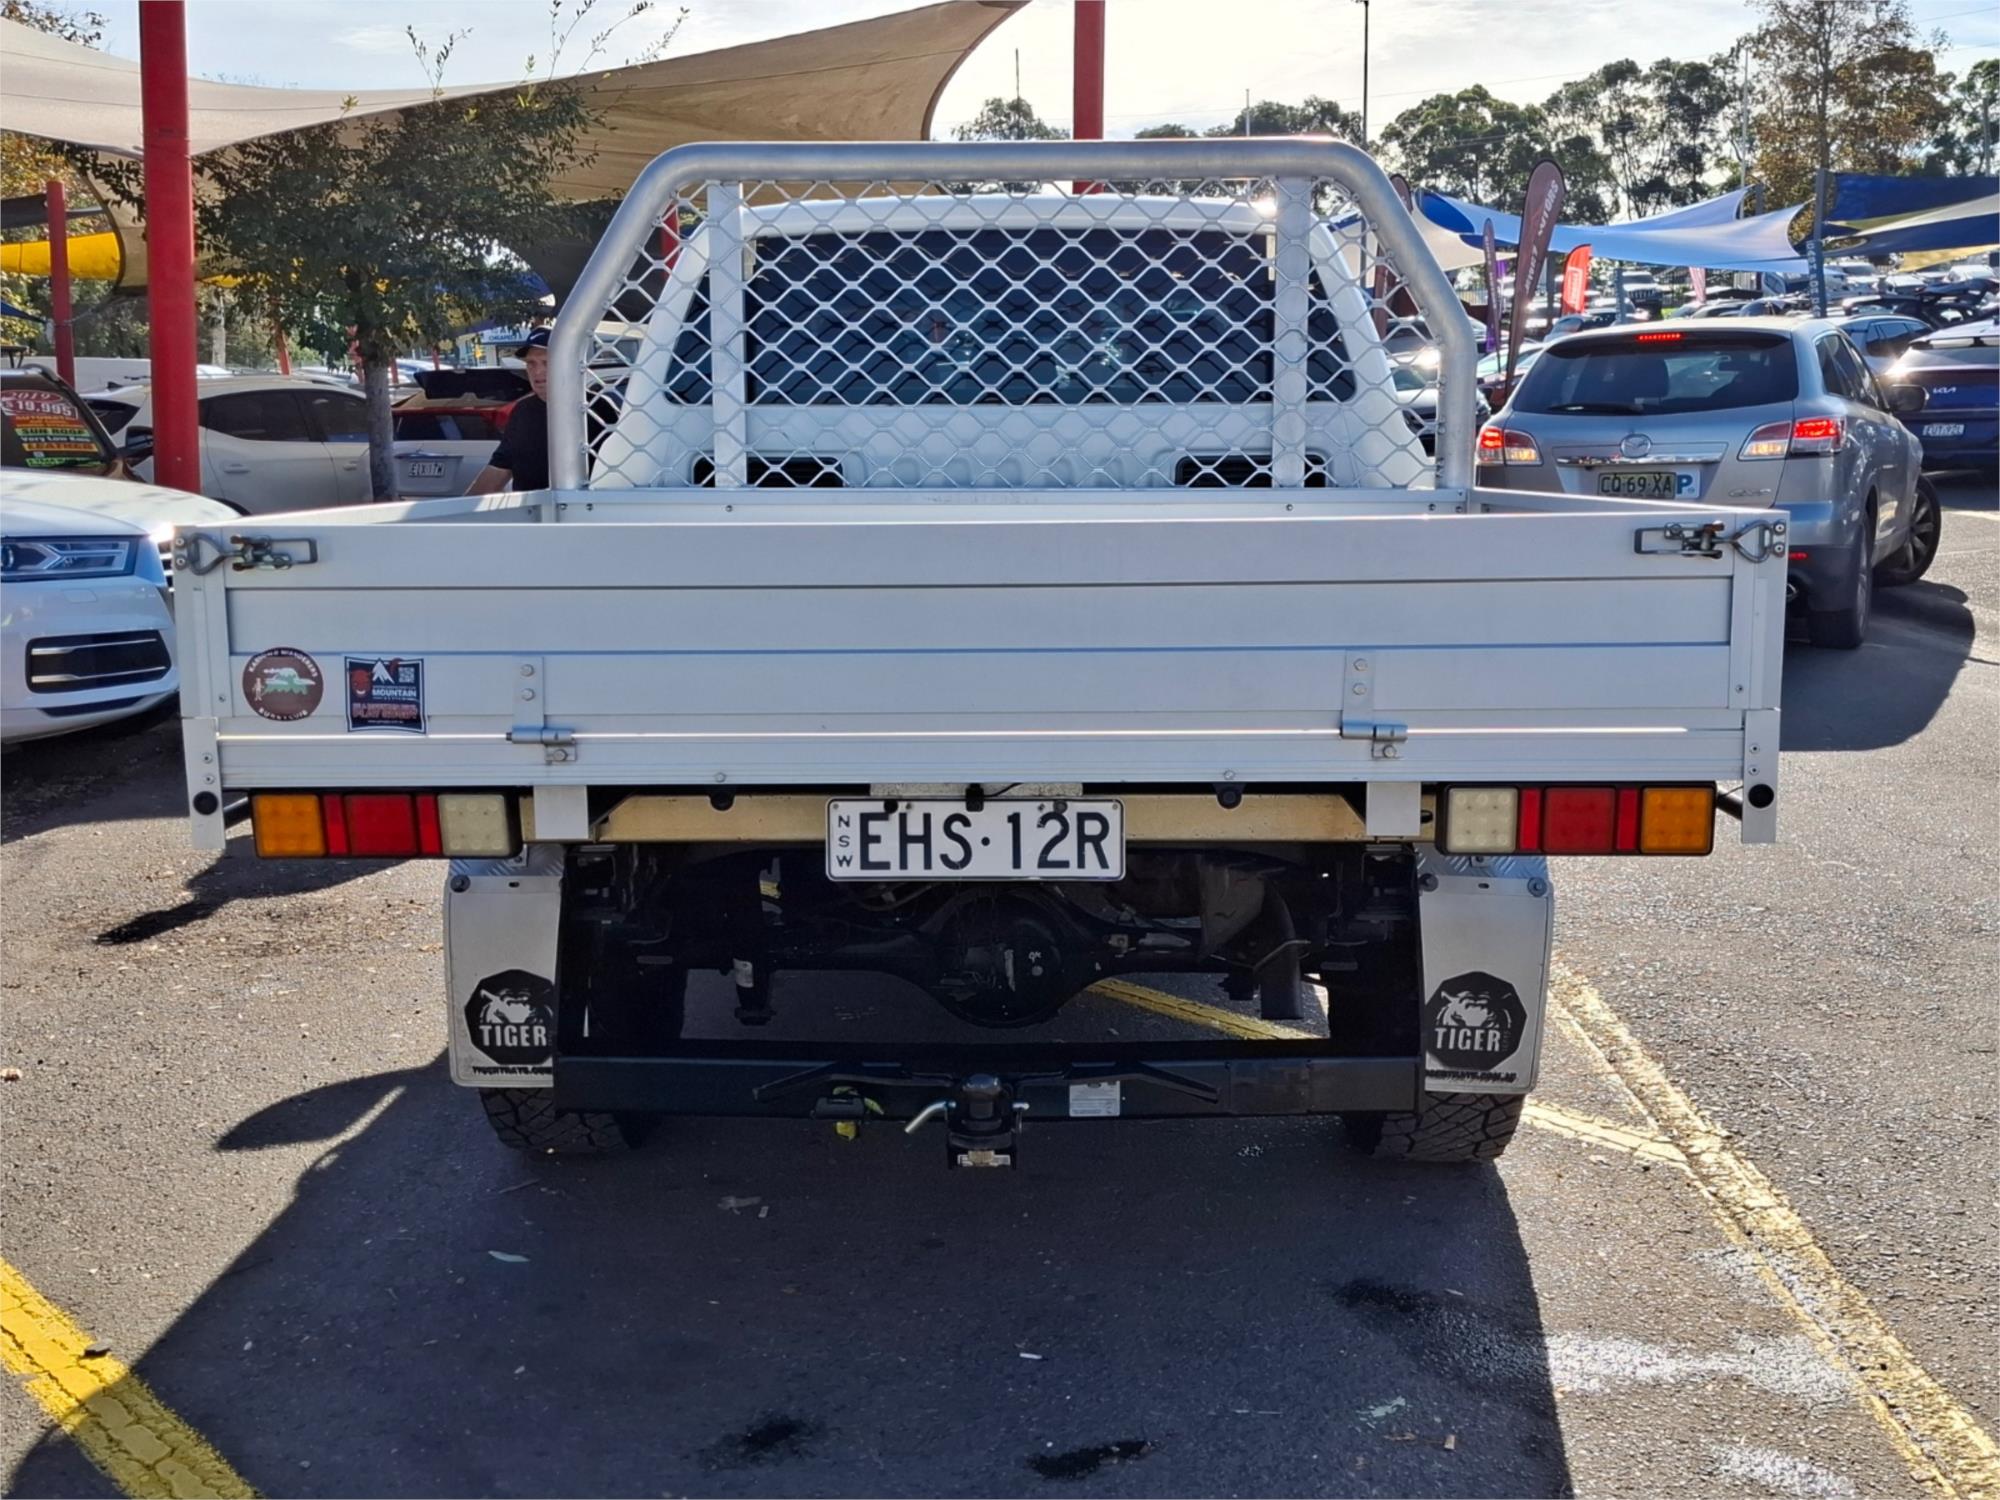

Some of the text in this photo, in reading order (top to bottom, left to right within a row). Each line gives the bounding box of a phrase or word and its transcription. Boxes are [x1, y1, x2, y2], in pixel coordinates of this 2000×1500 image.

[1677, 475, 1693, 494] P
[372, 689, 417, 697] MOUNTAIN
[478, 1024, 548, 1048] TIGER
[1434, 1027, 1502, 1052] TIGER
